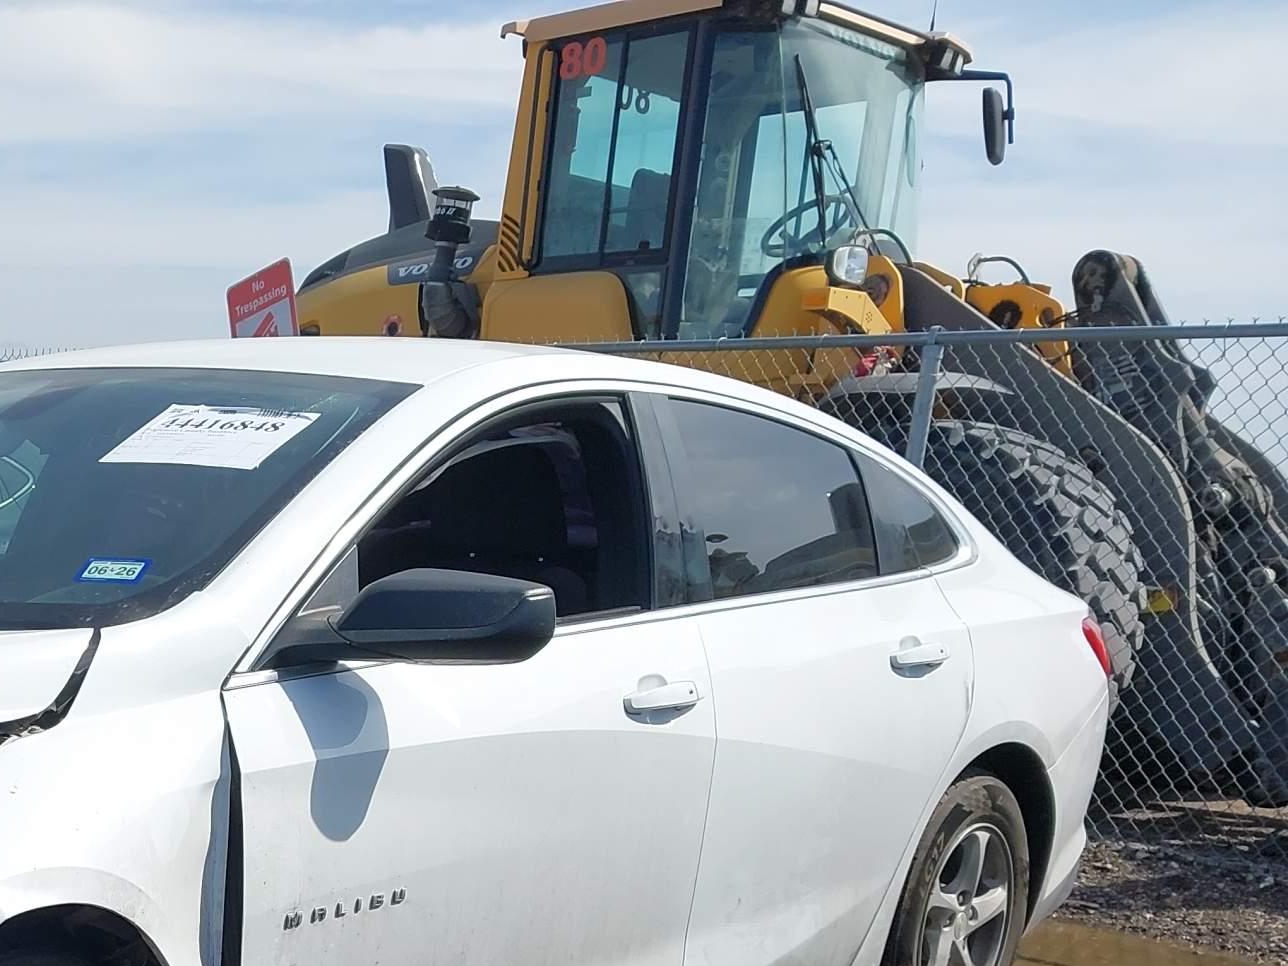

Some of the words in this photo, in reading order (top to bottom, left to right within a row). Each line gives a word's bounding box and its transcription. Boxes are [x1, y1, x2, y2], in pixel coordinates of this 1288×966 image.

[559, 36, 607, 80] 80
[398, 256, 473, 277] VOO
[252, 280, 265, 293] No
[235, 284, 287, 316] Trespassing
[161, 417, 285, 433] 44416848
[283, 887, 407, 931] MALIBU
